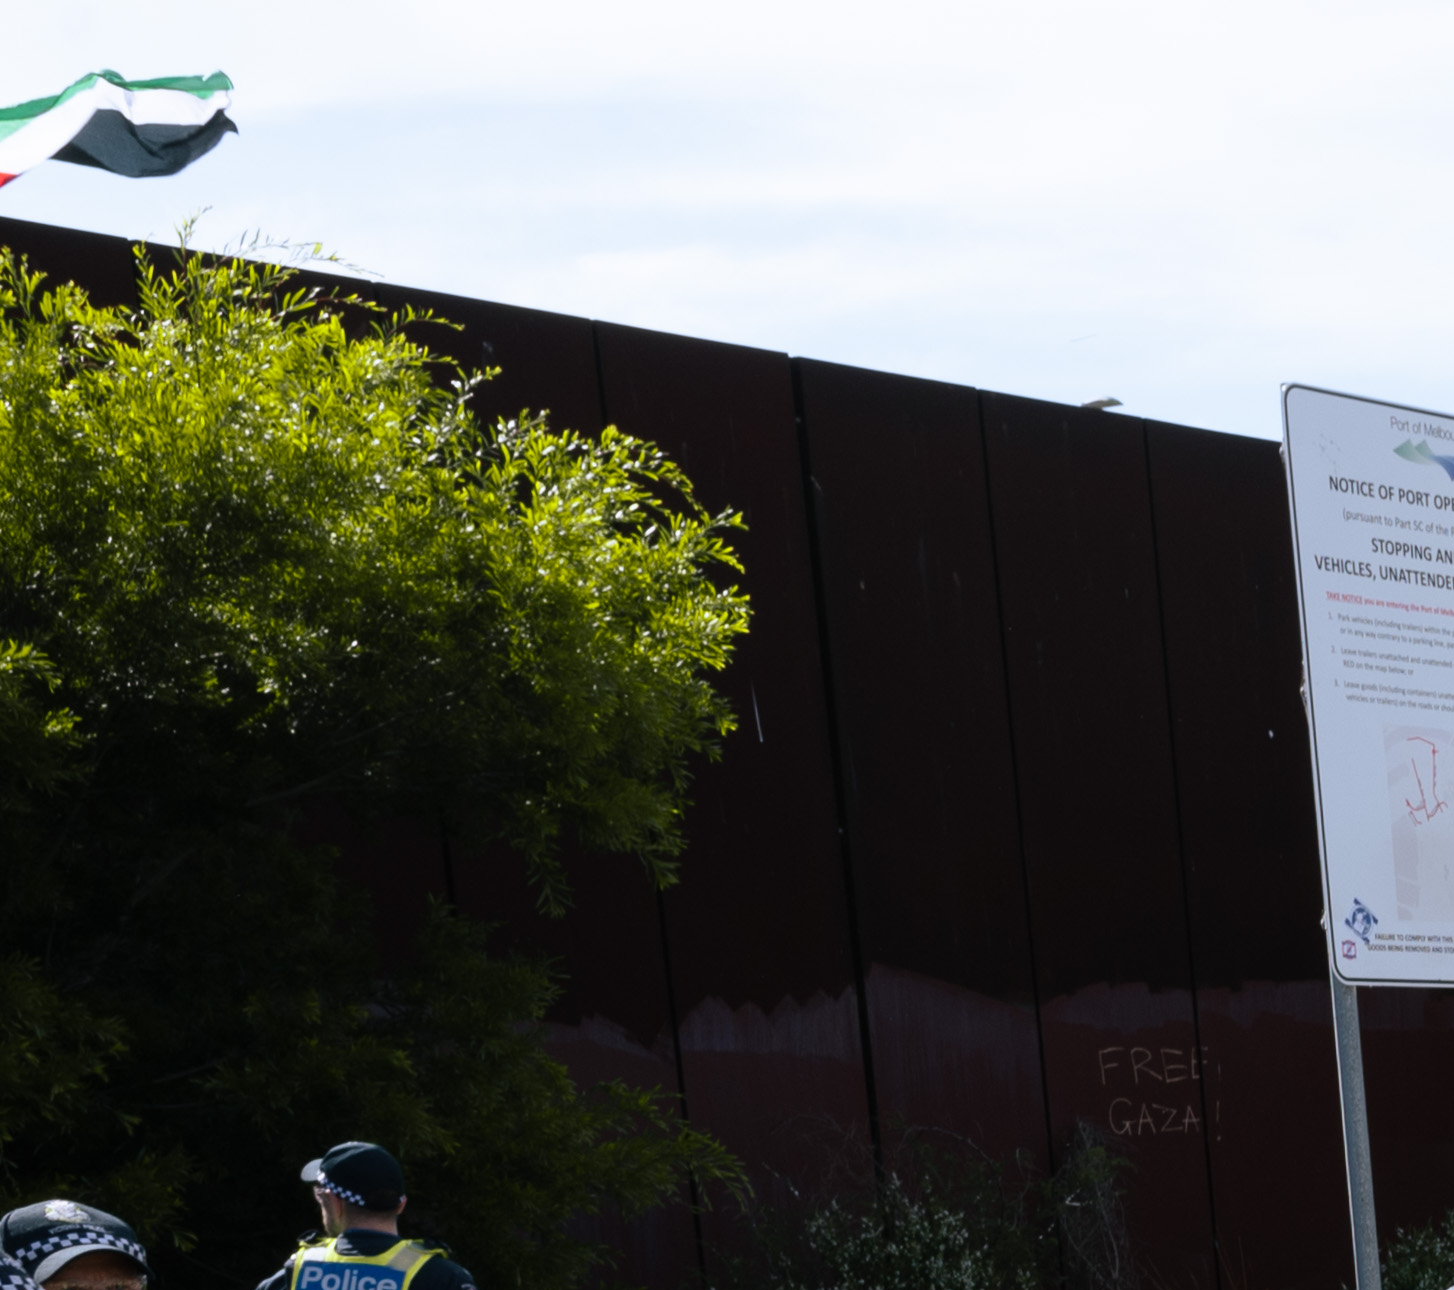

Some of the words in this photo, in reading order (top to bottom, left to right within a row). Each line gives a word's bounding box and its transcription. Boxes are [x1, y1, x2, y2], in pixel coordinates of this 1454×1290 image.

[1390, 416, 1410, 433] Port
[1412, 419, 1423, 435] of
[1328, 475, 1376, 498] NOTICE
[1378, 484, 1396, 501] OF
[1398, 487, 1431, 507] PORT
[1342, 507, 1383, 525] (pursuant
[1384, 513, 1394, 527] to
[1394, 514, 1411, 530] Part
[1425, 520, 1436, 534] of
[1436, 522, 1449, 536] the
[1371, 537, 1432, 562] STOPPING
[1314, 554, 1377, 581] VEHICLES,
[1098, 1047, 1209, 1086] FREE
[1108, 1097, 1222, 1141] GAZA!
